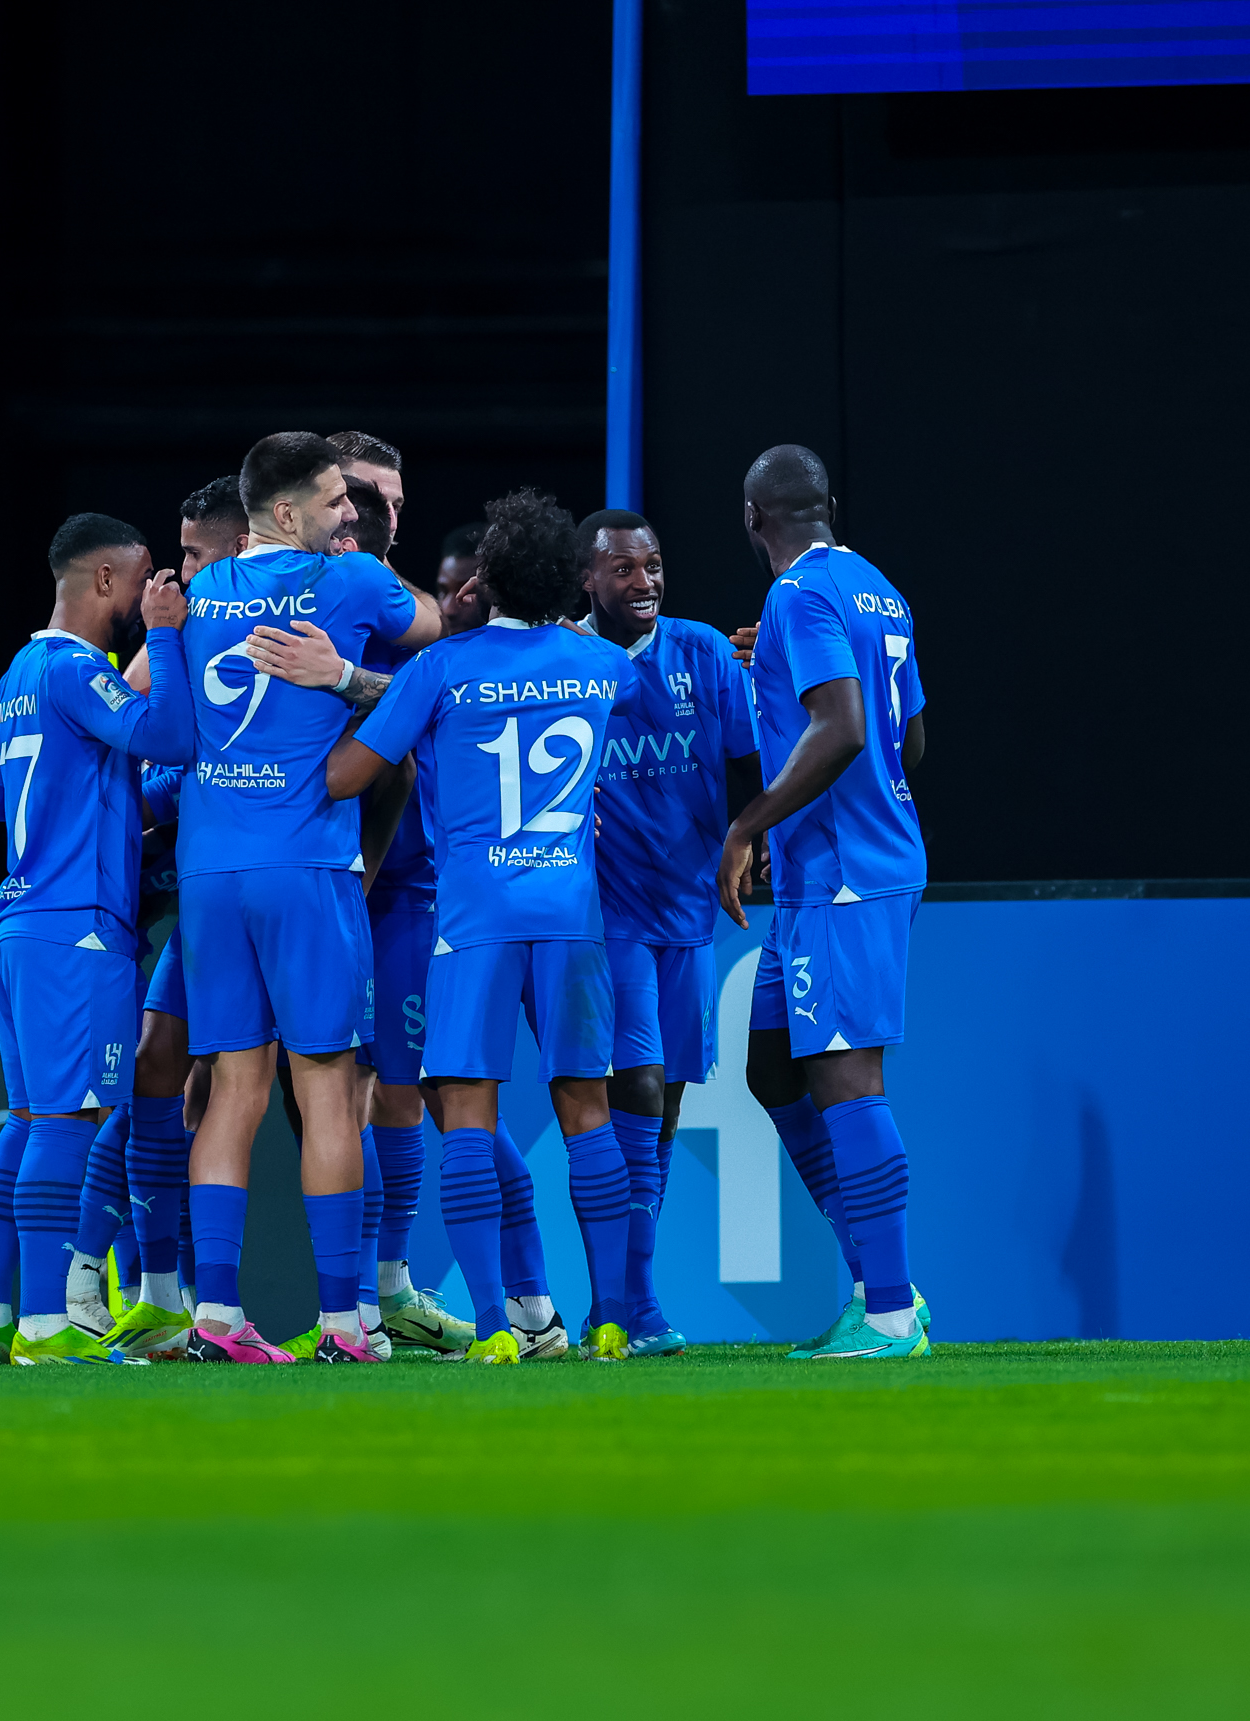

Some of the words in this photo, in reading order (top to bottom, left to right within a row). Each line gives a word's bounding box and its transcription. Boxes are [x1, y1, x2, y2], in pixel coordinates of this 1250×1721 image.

[187, 588, 317, 620] MITROVIĆ
[203, 640, 273, 751] 9
[449, 684, 472, 704] Y.
[602, 730, 696, 768] AVVY
[211, 777, 286, 788] FOUNDATION
[213, 763, 286, 777] ALHILAL
[476, 716, 594, 839] 12
[596, 770, 639, 783] AMES
[648, 763, 699, 777] GROUP
[0, 733, 44, 861] 7
[507, 857, 578, 868] FOUNDATION
[791, 956, 812, 999] 3
[402, 994, 425, 1035] 8
